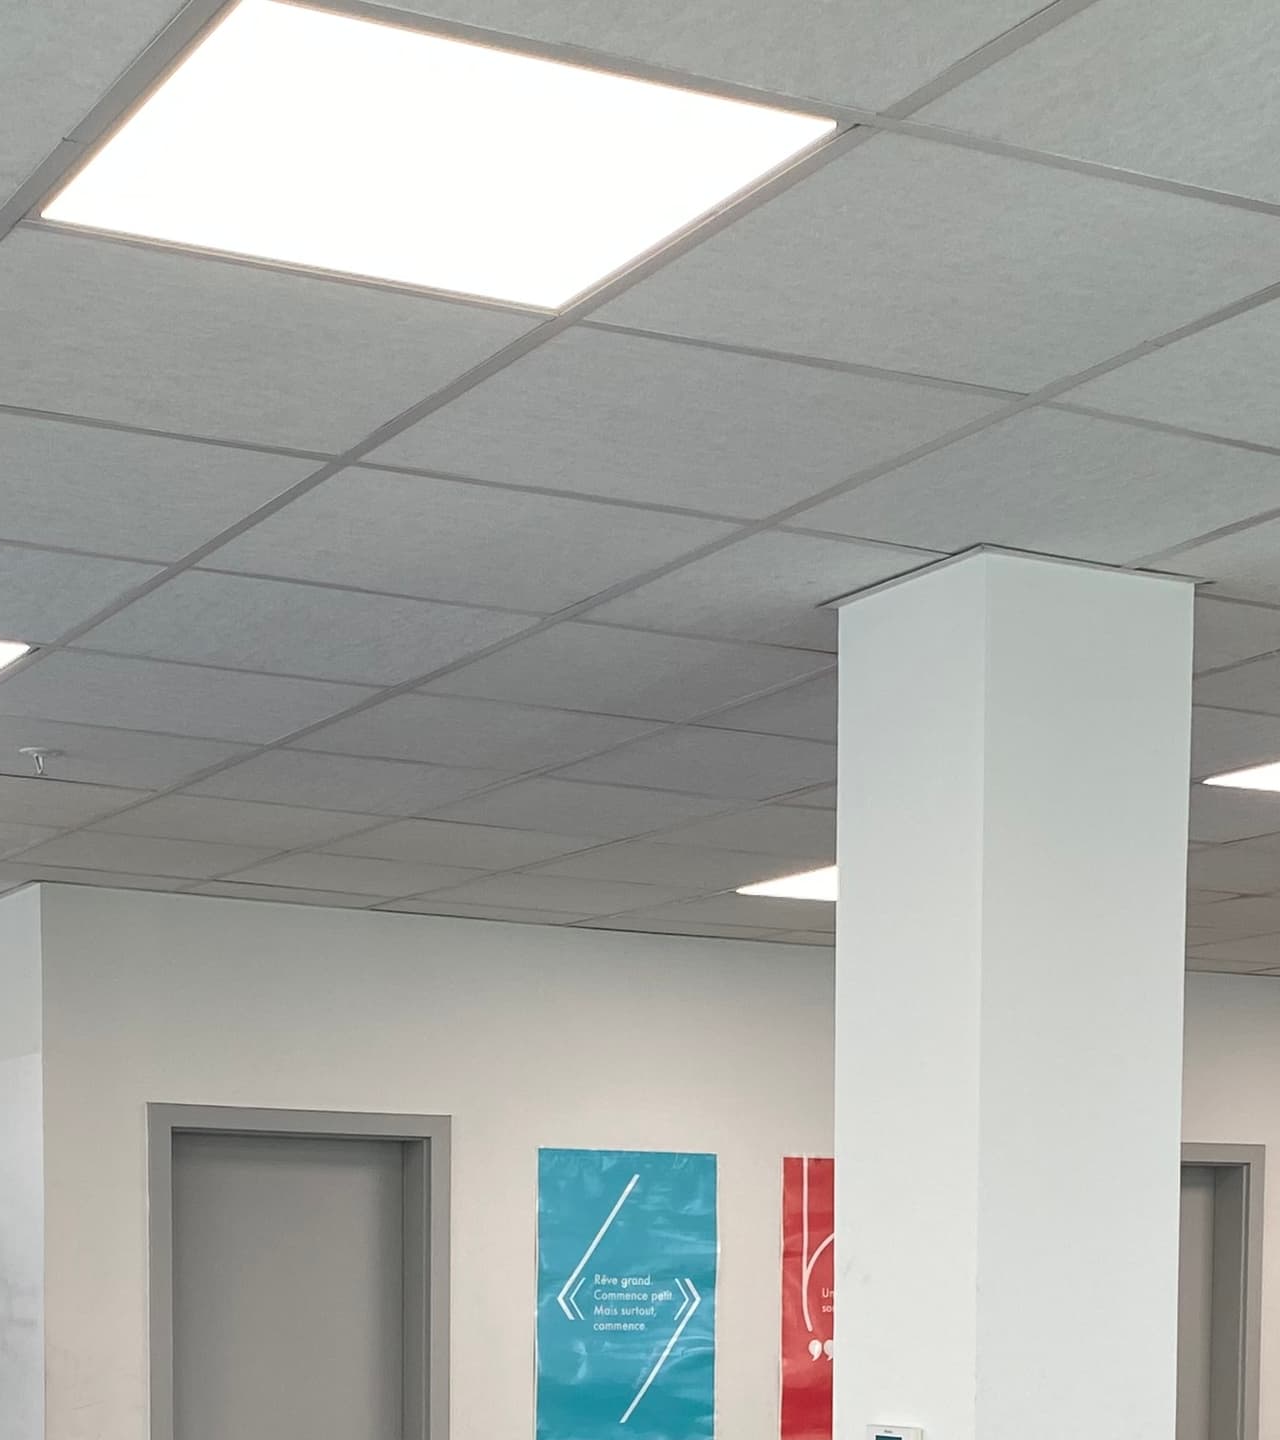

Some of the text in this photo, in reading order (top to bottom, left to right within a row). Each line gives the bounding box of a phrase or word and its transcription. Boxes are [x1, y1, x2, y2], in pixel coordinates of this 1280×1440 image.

[594, 1273, 618, 1285] Rêve
[593, 1288, 649, 1301] Commence
[593, 1304, 619, 1316] Mais
